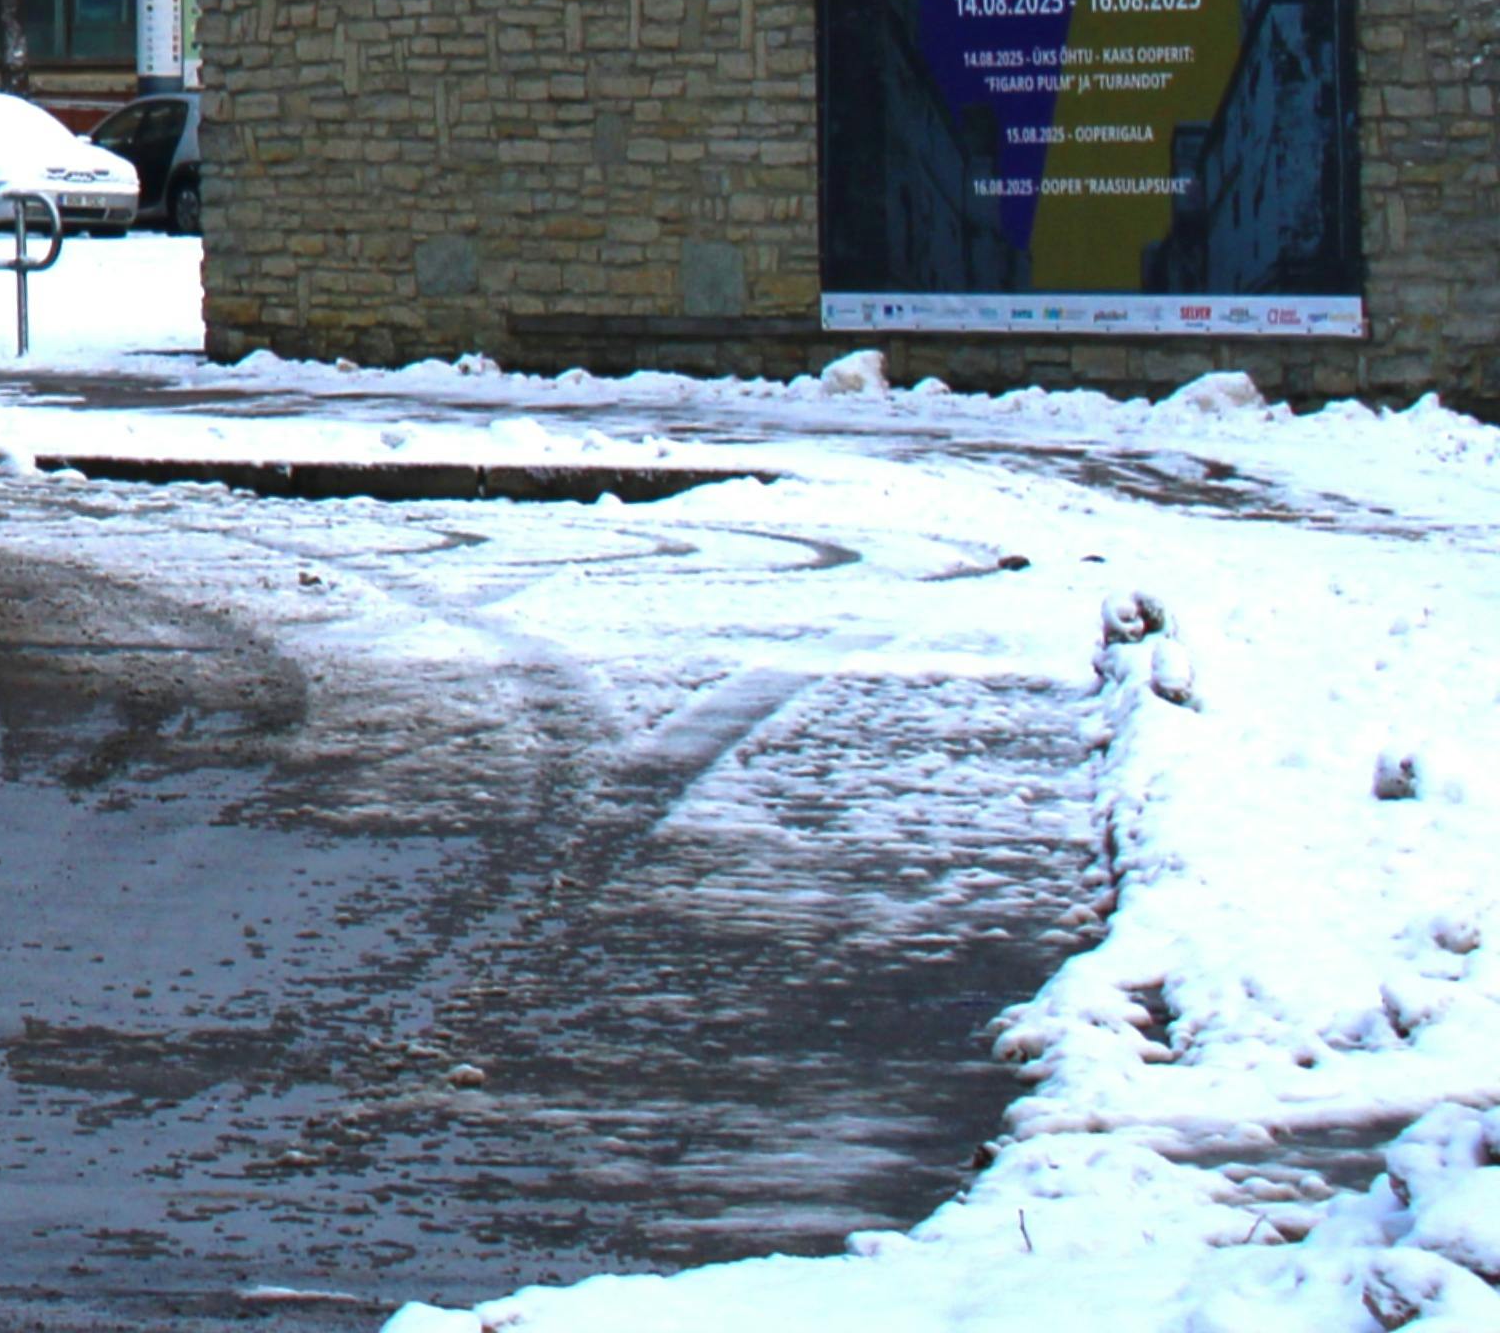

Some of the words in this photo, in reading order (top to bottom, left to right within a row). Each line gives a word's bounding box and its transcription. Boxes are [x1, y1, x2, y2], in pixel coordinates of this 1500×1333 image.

[963, 50, 1024, 68] 14.08.2025
[1032, 46, 1057, 66] ÜKS
[1060, 45, 1093, 66] ÕHTU
[1102, 47, 1134, 65] KAKS
[1136, 45, 1195, 64] OOPERIT:
[1078, 74, 1091, 94] JA
[1005, 125, 1065, 144] 15.08.2025
[1074, 124, 1154, 143] OOPERIGALA
[973, 178, 1033, 196] 16.08.2025
[1041, 178, 1082, 194] OOPER
[1180, 305, 1212, 320] SELVER
